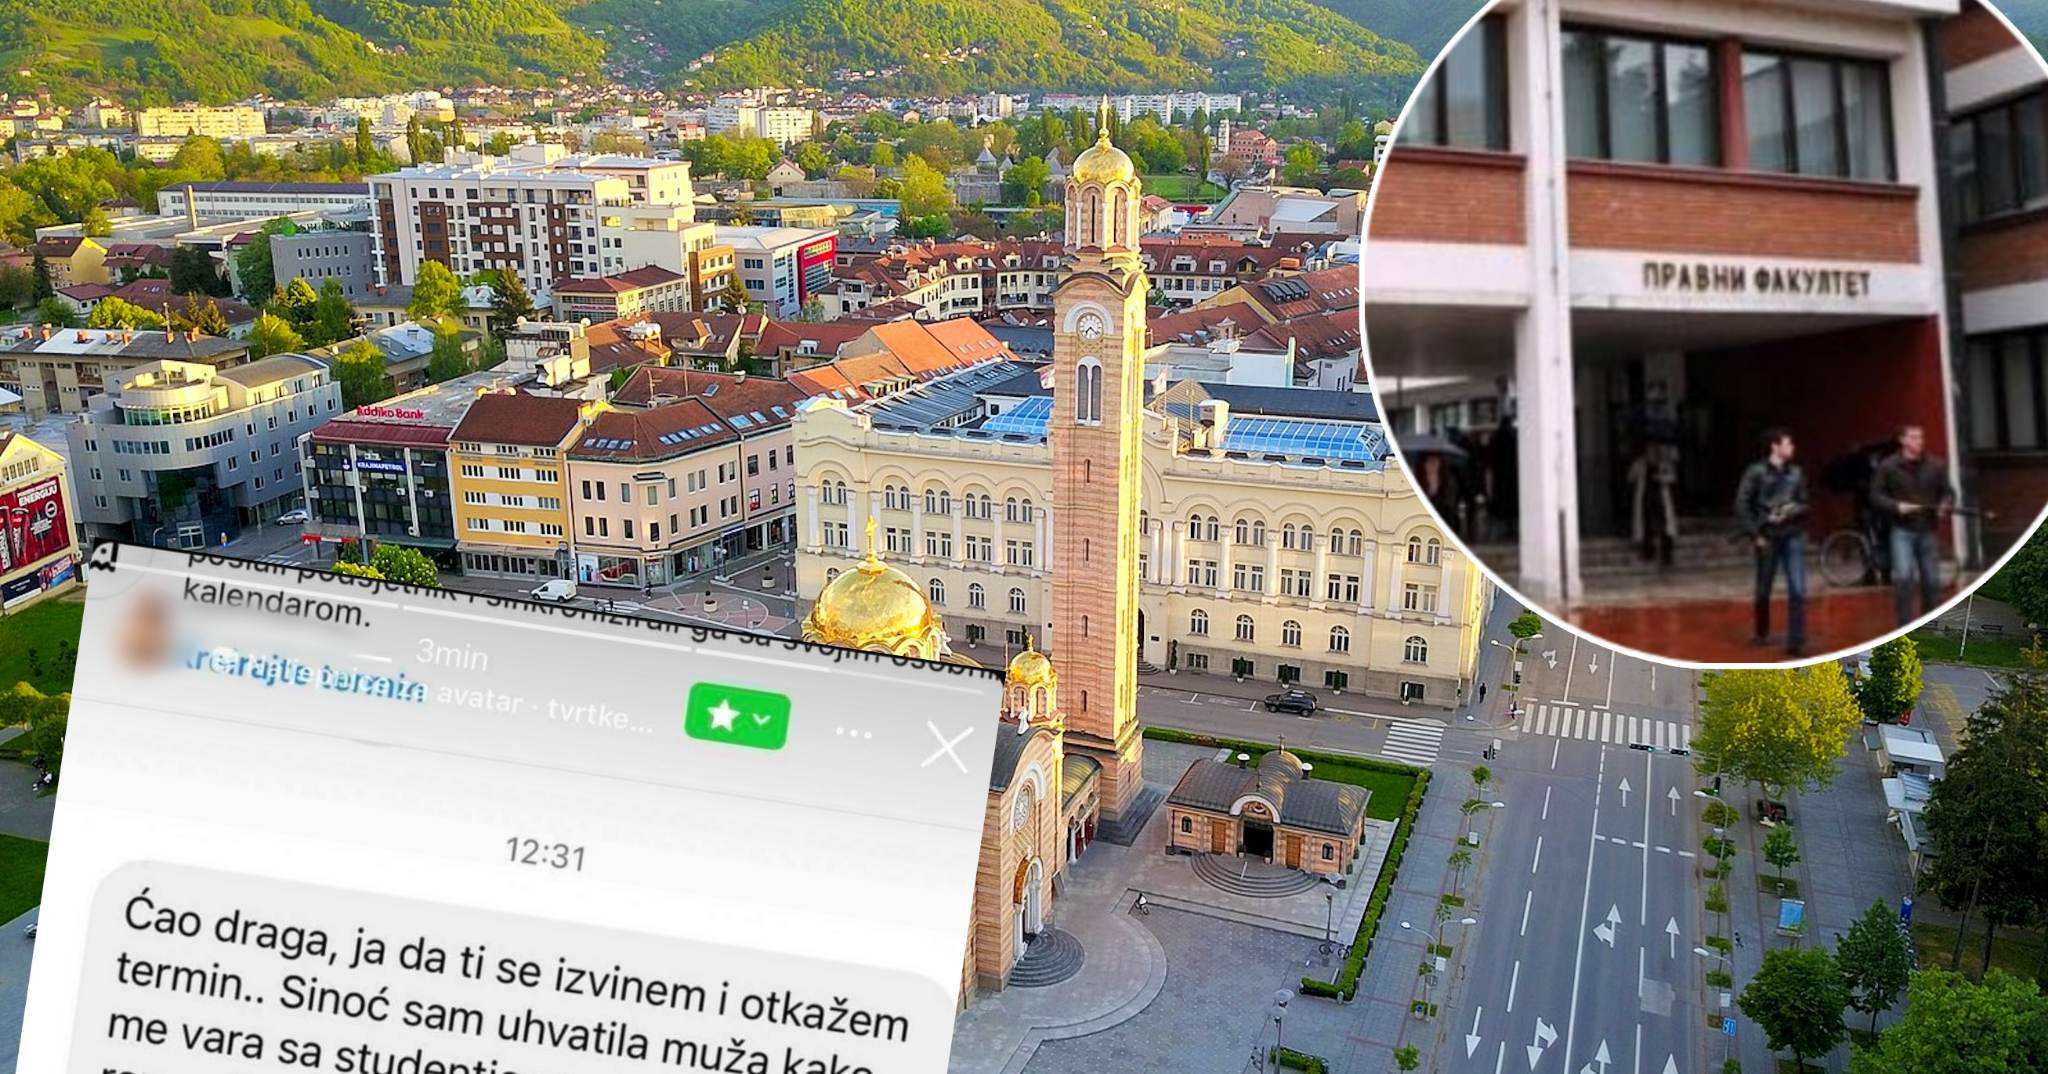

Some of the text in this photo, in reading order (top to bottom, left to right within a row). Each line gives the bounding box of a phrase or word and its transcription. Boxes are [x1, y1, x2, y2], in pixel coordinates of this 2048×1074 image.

[1643, 262, 1870, 297] ПРАВНИ ФАКУЛТЕТ
[356, 405, 424, 419] Addiko Bank
